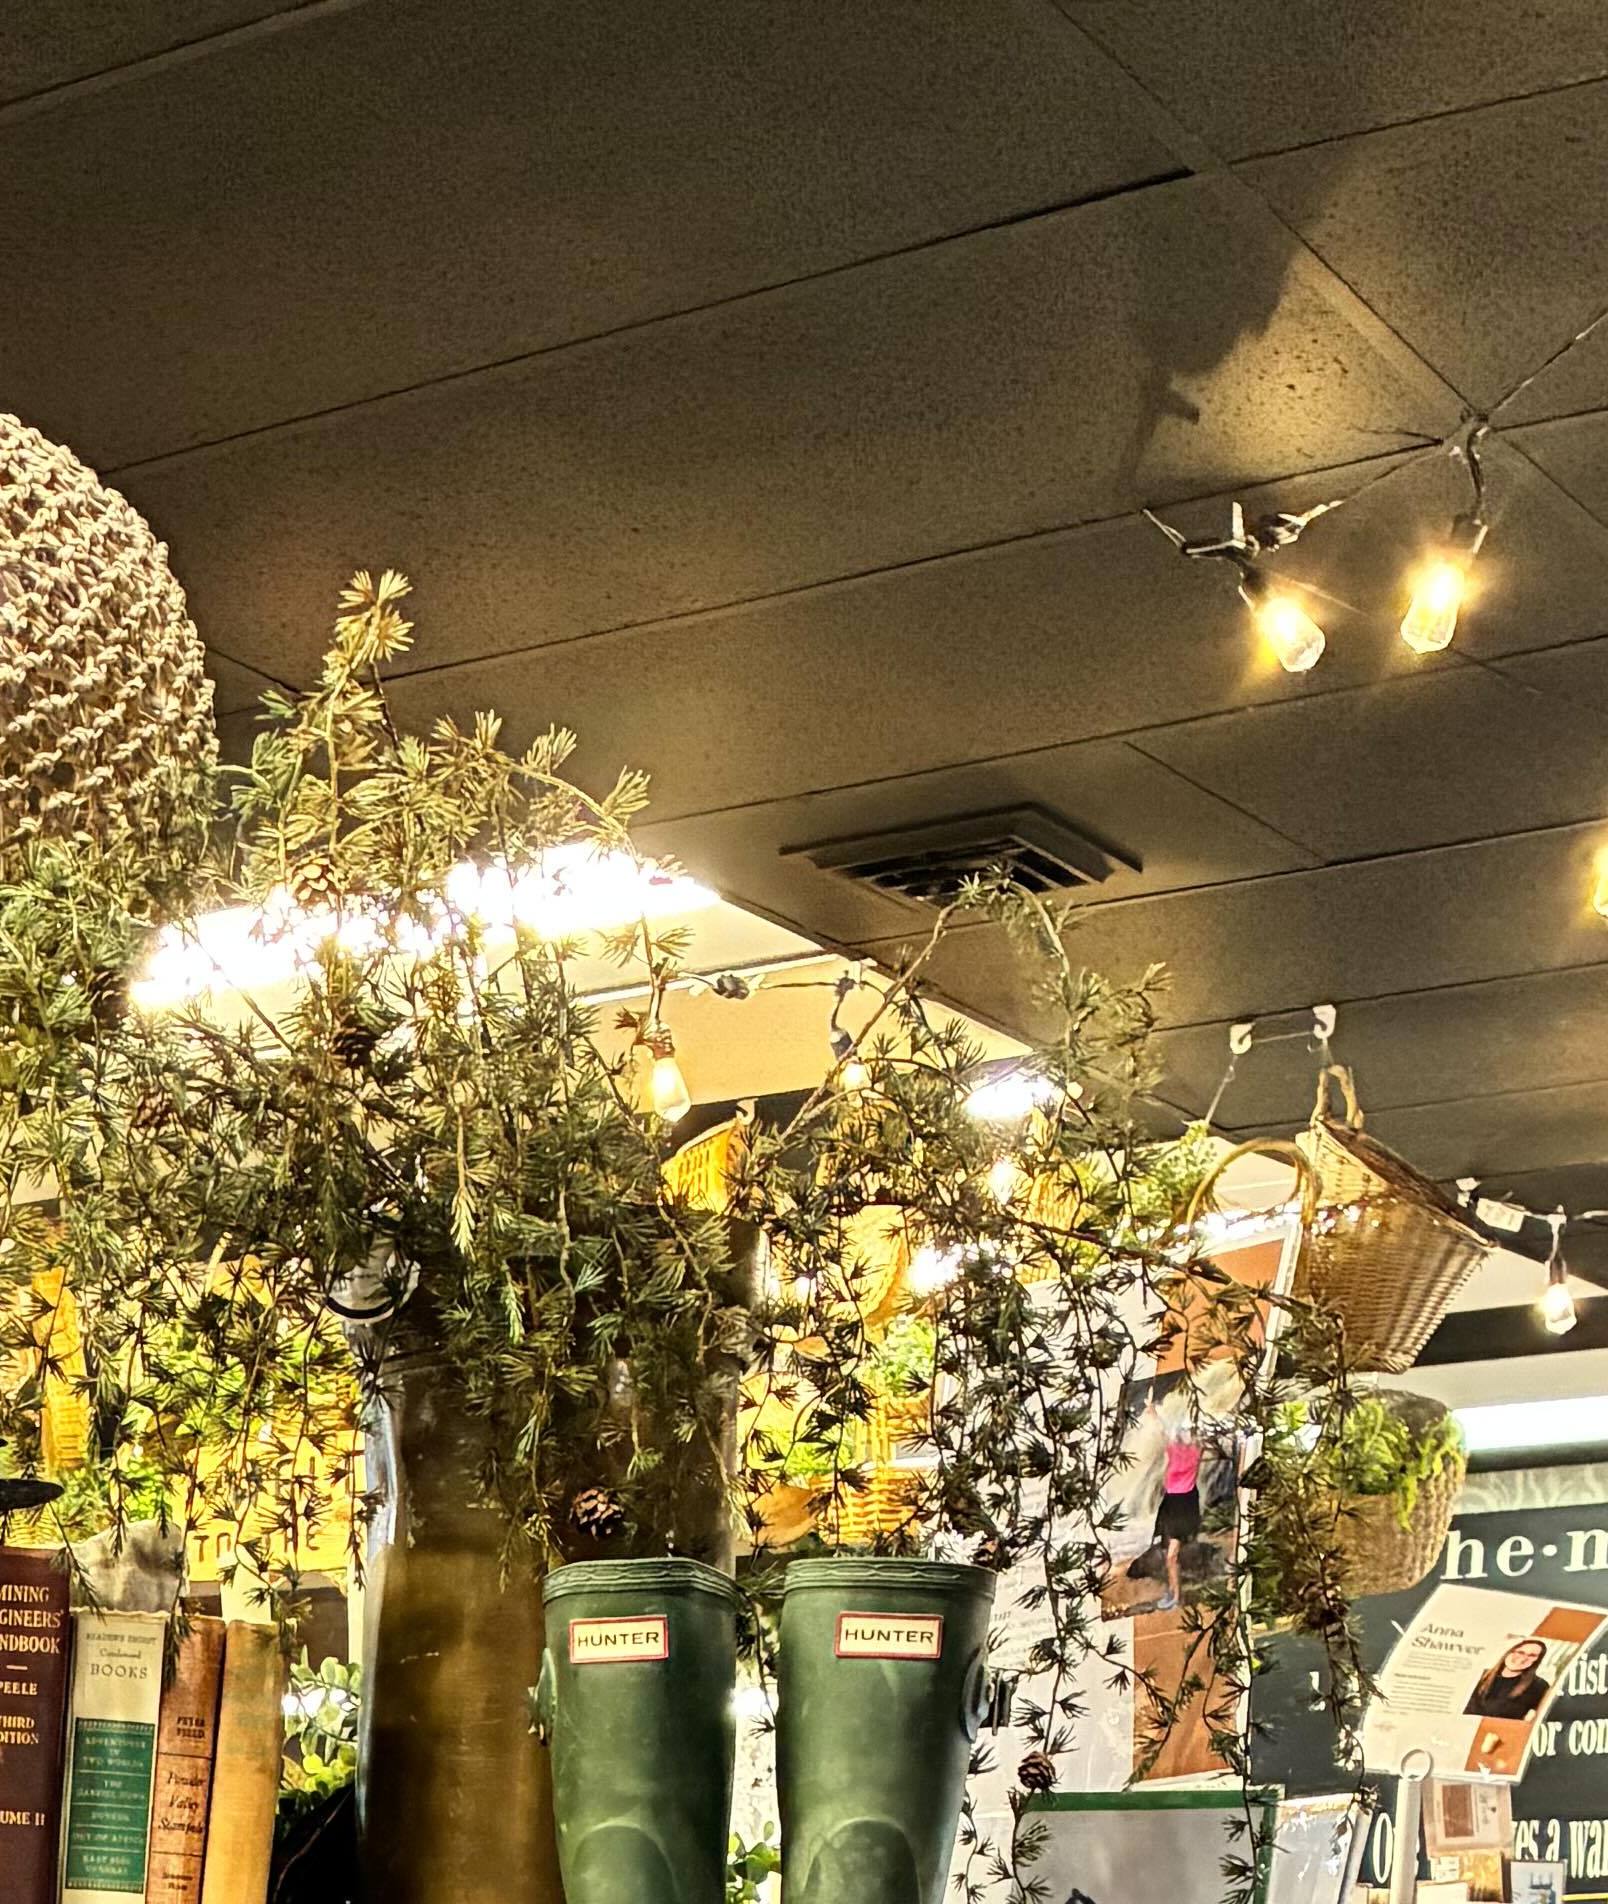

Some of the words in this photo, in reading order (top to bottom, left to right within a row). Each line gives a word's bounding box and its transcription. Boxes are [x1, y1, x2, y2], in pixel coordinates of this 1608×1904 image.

[576, 1631, 661, 1648] HUNTER
[844, 1627, 935, 1645] HUNTER
[1421, 1623, 1465, 1639] Anna
[90, 1663, 149, 1680] BOOKS
